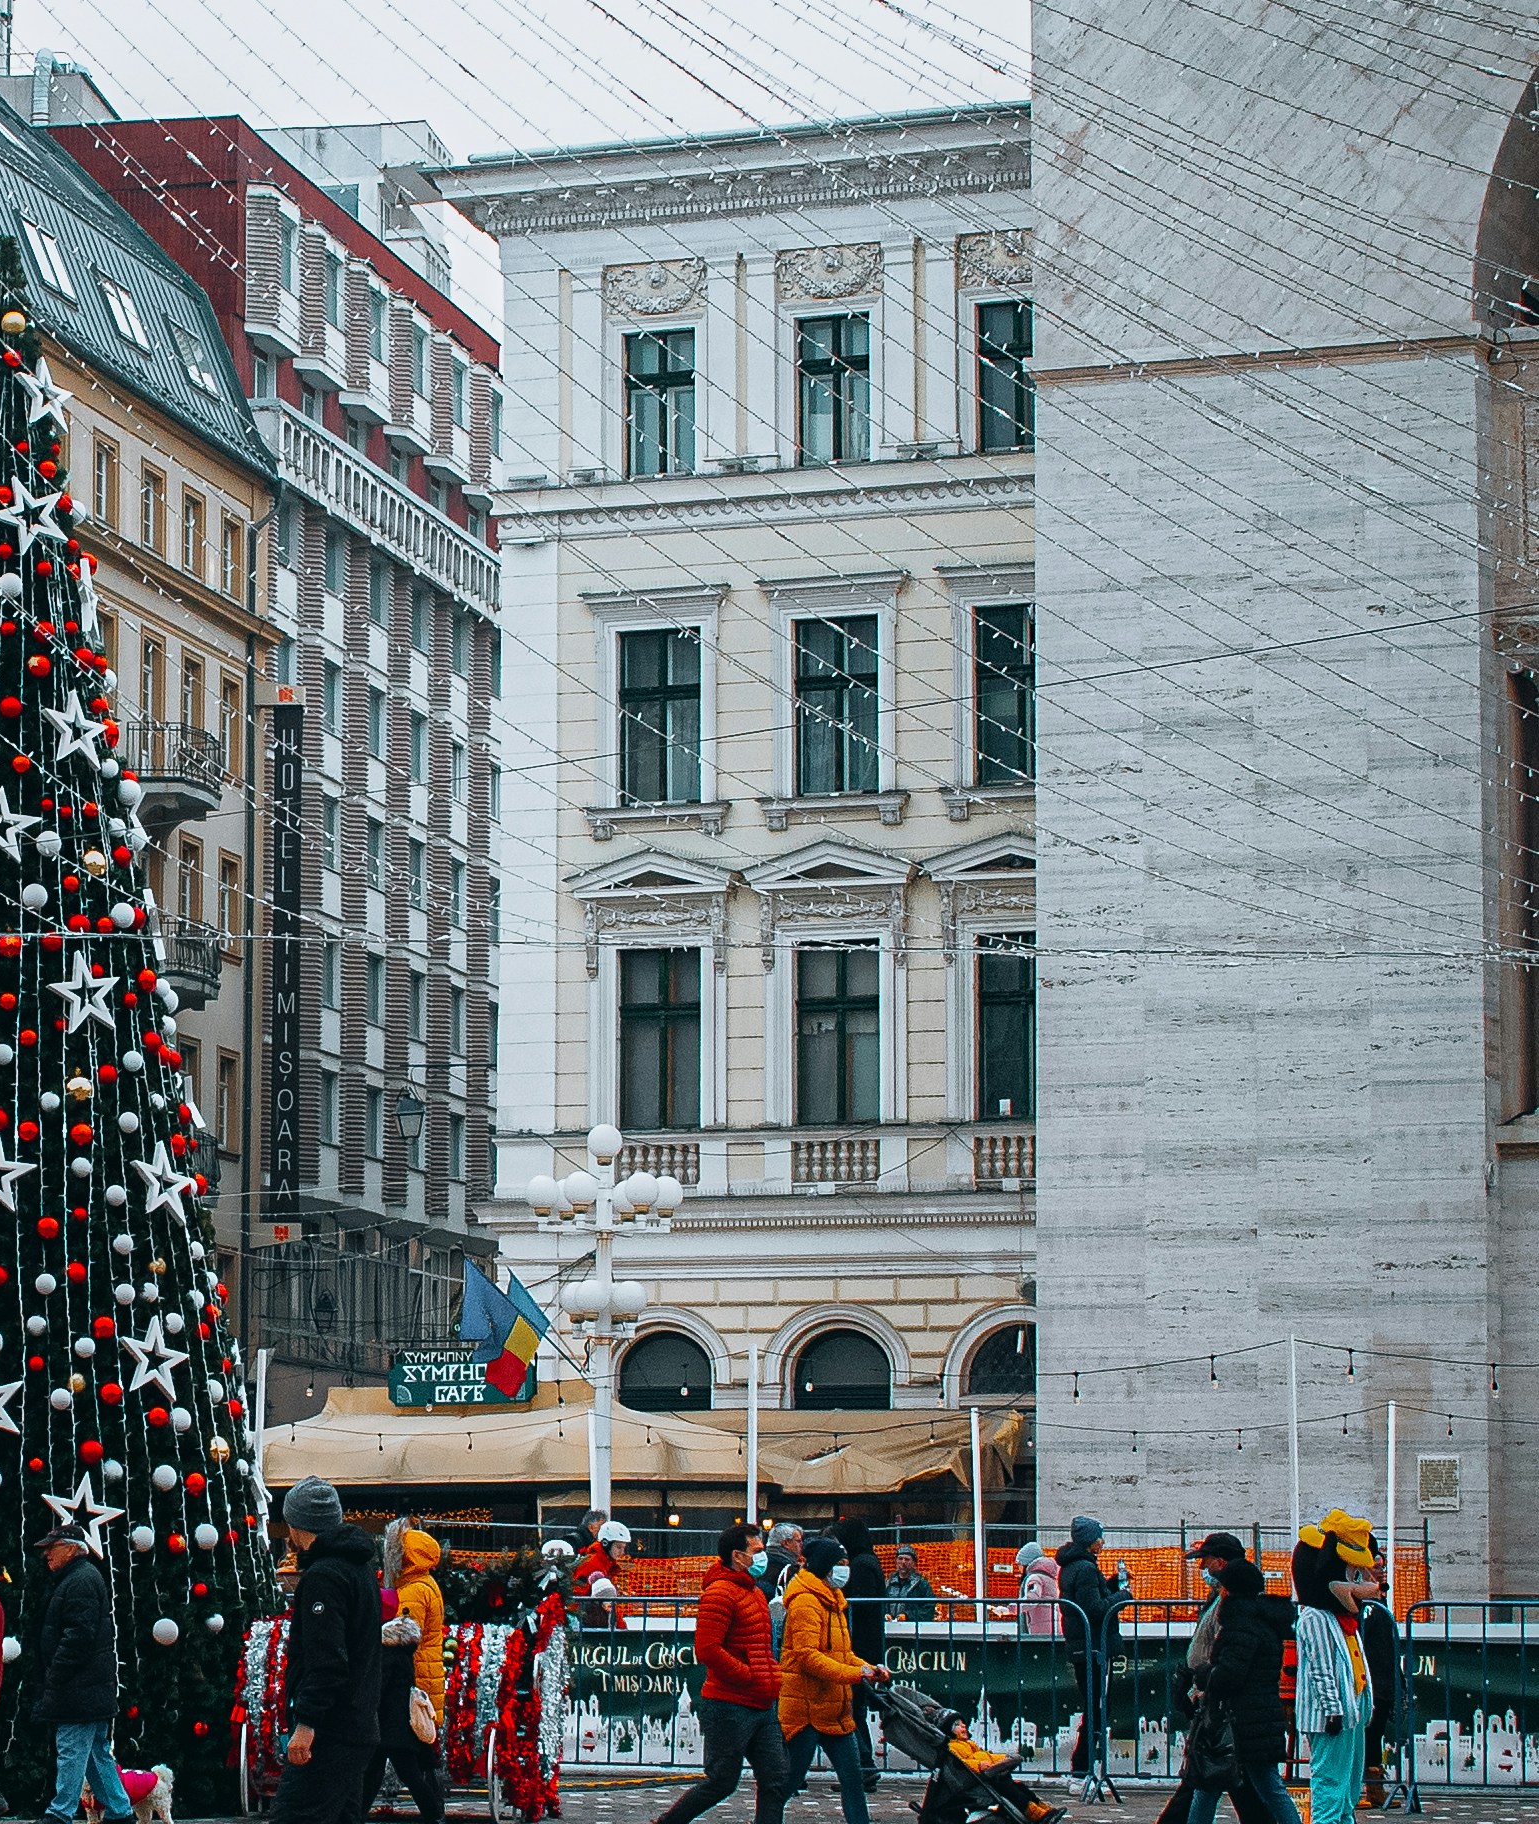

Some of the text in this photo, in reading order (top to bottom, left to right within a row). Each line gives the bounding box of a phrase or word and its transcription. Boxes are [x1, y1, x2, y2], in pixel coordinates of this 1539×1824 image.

[281, 729, 294, 893] HOTEL
[404, 1351, 473, 1364] SYMPHONY
[402, 1363, 488, 1383] SYMPHO
